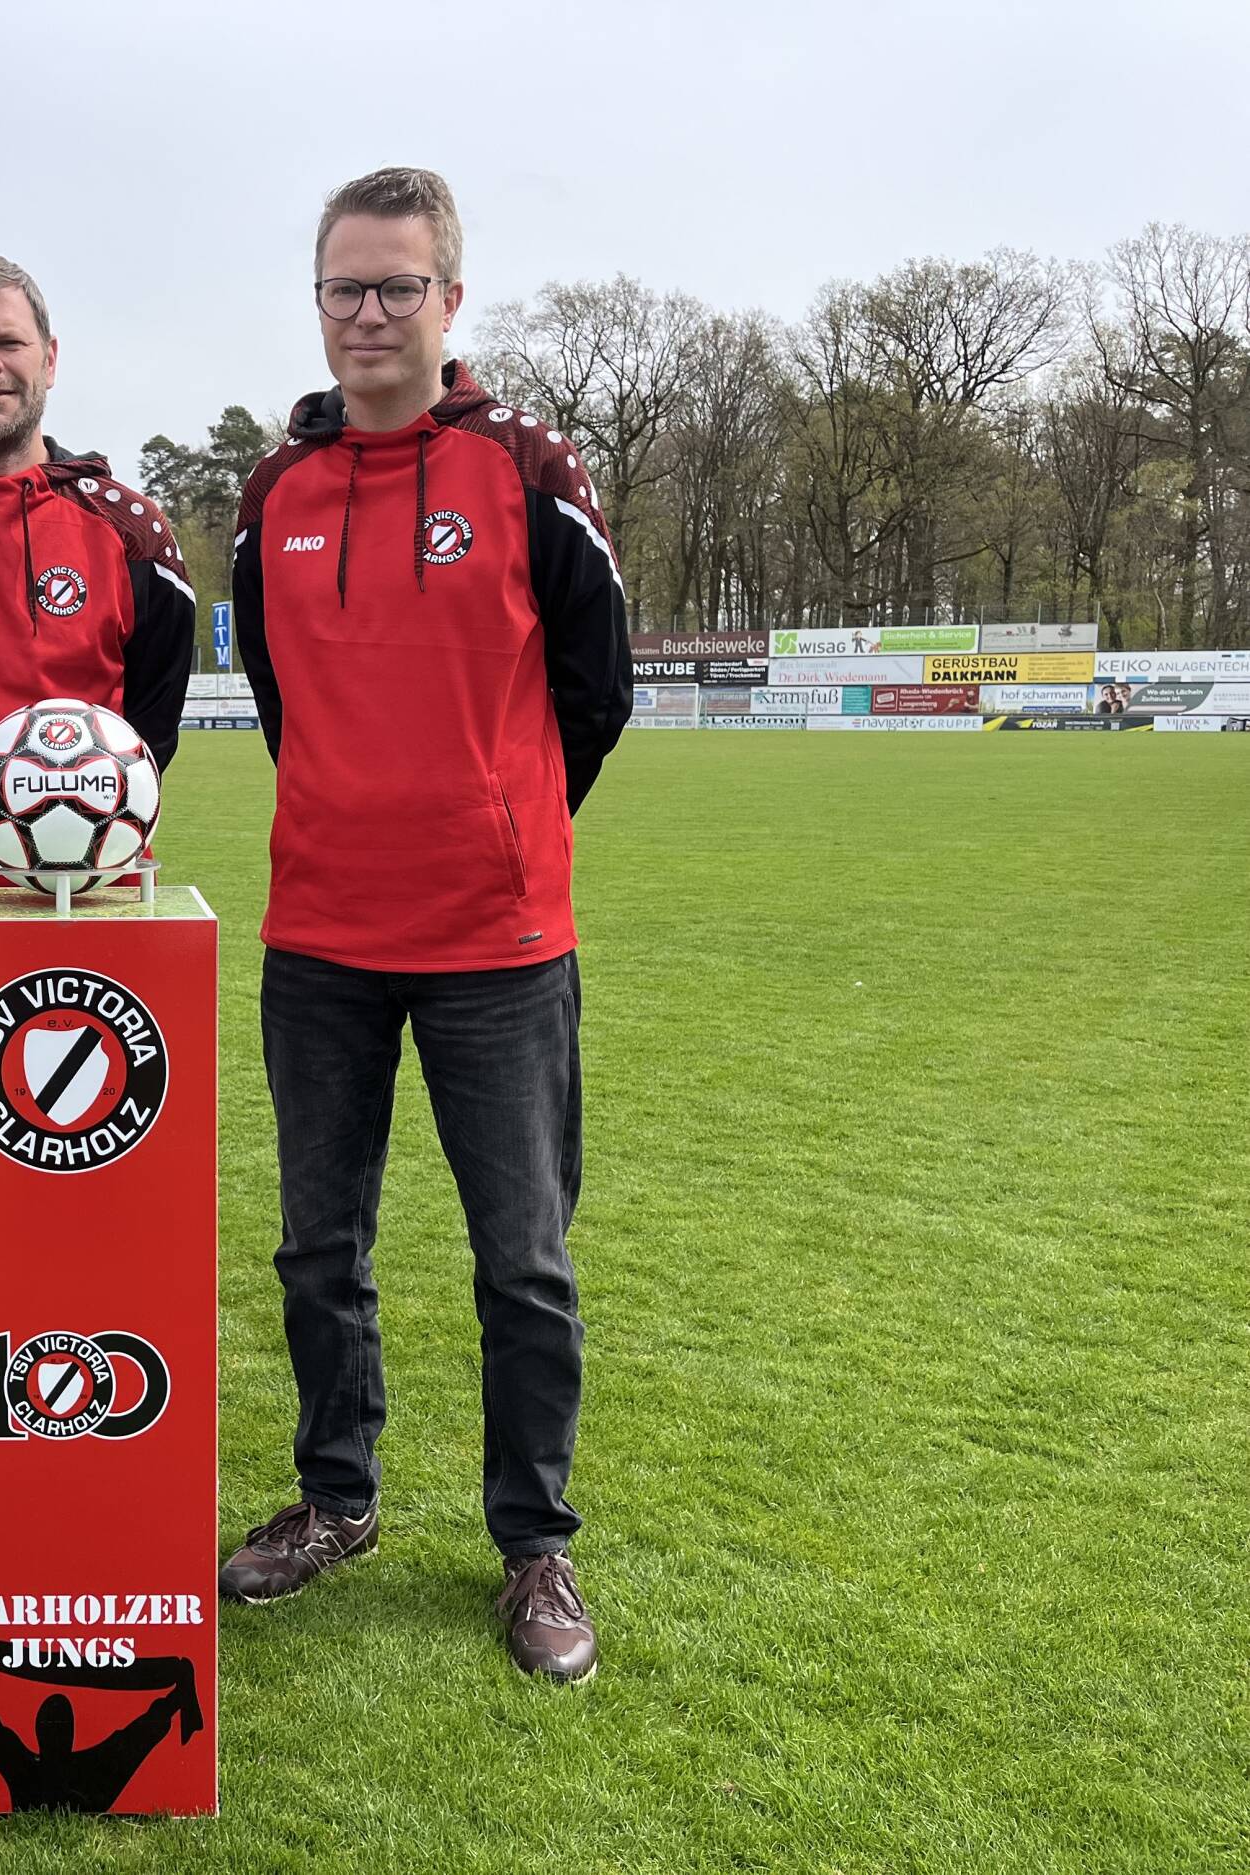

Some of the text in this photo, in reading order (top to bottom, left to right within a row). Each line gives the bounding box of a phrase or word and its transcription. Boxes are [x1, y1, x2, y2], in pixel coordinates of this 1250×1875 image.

[433, 511, 472, 540] VICTORIA
[283, 536, 325, 552] JAKO
[37, 566, 86, 594] TSV VICTORIA
[38, 595, 83, 615] CLARHOLZ
[663, 636, 765, 655] Buschsieweke
[799, 641, 846, 653] WISAG
[932, 657, 1018, 669] GERÜSTBAU
[1098, 660, 1151, 672] KEIKO
[797, 672, 820, 682] Dirk
[825, 672, 888, 682] Wiedemann
[932, 671, 1017, 681] DALKMANN
[1001, 690, 1083, 700] hof scharmann
[928, 718, 979, 728] GRUPPE
[42, 738, 79, 750] CLARHOLZ
[13, 774, 117, 794] FULUMA
[20, 977, 158, 1068] VICTORIA
[14, 1088, 115, 1096] 19 20
[9, 1336, 110, 1384] TSV VICTORIA
[14, 1399, 107, 1436] CLARHOLZ
[2, 1637, 136, 1668] JUNGS
